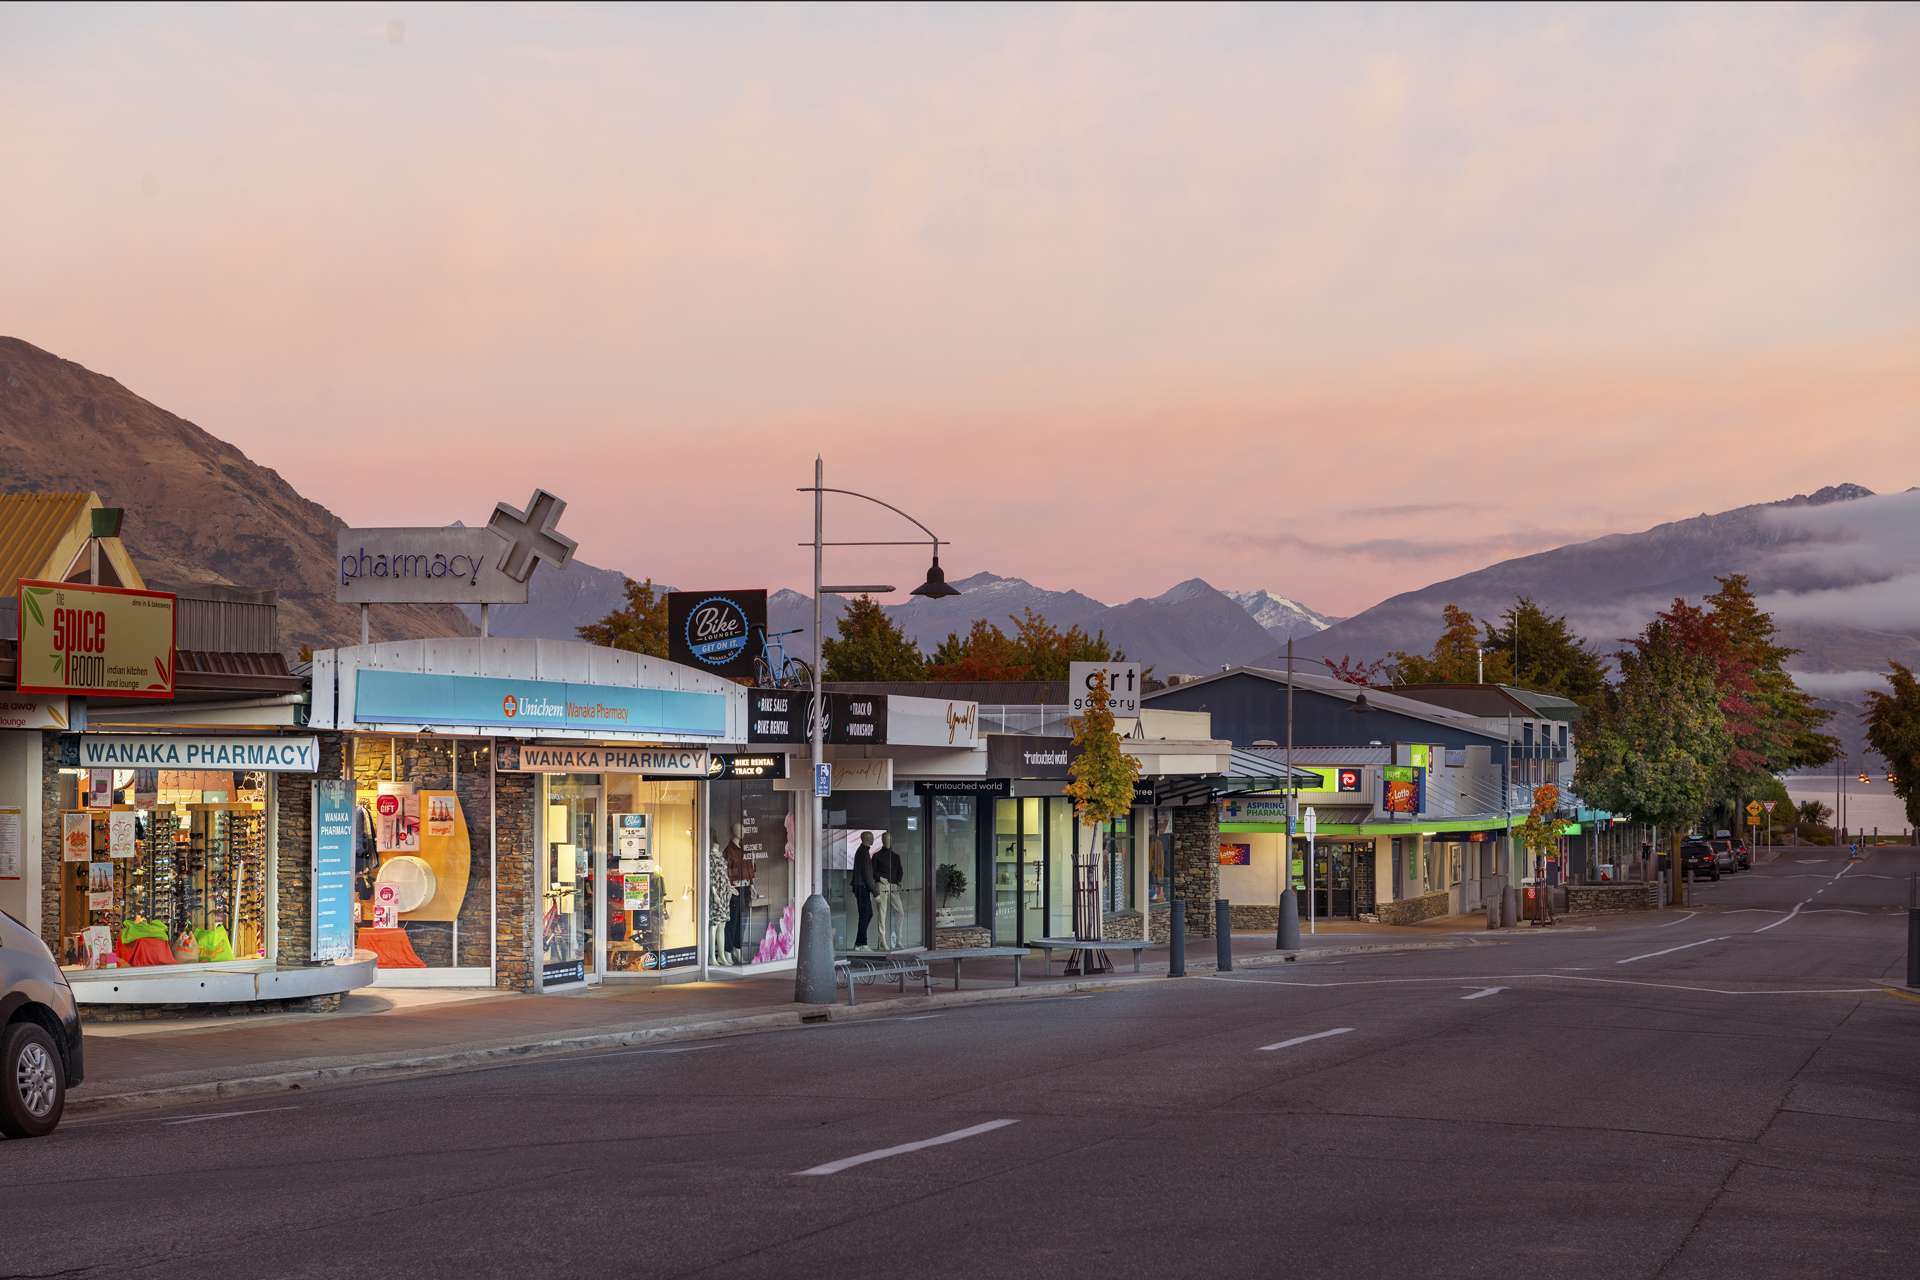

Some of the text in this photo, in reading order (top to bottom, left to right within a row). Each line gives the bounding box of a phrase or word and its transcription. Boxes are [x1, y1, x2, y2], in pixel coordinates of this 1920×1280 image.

[341, 547, 485, 586] pharmacy
[56, 592, 65, 606] the
[695, 607, 738, 637] Bike
[704, 631, 733, 641] LOUNGE
[702, 644, 715, 653] GET
[107, 666, 148, 676] indian kitchen
[106, 678, 139, 690] and lounge
[11, 703, 37, 712] away
[519, 697, 628, 723] Unichem Wanaka Pharmacy
[760, 698, 788, 713] BIKE SALES
[852, 702, 867, 716] TRACK
[1073, 698, 1135, 711] gaery
[757, 720, 789, 735] BIKE RENTAL
[849, 722, 874, 736] WORKSHOP
[86, 743, 310, 765] WANAKA PHARMACY
[1030, 750, 1068, 765] untouched world
[525, 751, 702, 770] WANAKA PHARMACY
[750, 758, 774, 766] RENTAL
[735, 767, 755, 775] TRACK
[934, 781, 1003, 791] untouched world
[1394, 788, 1410, 800] Lotto
[380, 805, 395, 813] GIFT
[1247, 809, 1287, 817] PHARMAC
[325, 812, 349, 823] WANAKA
[320, 826, 352, 836] PHARMACY
[1220, 850, 1236, 858] Lotto
